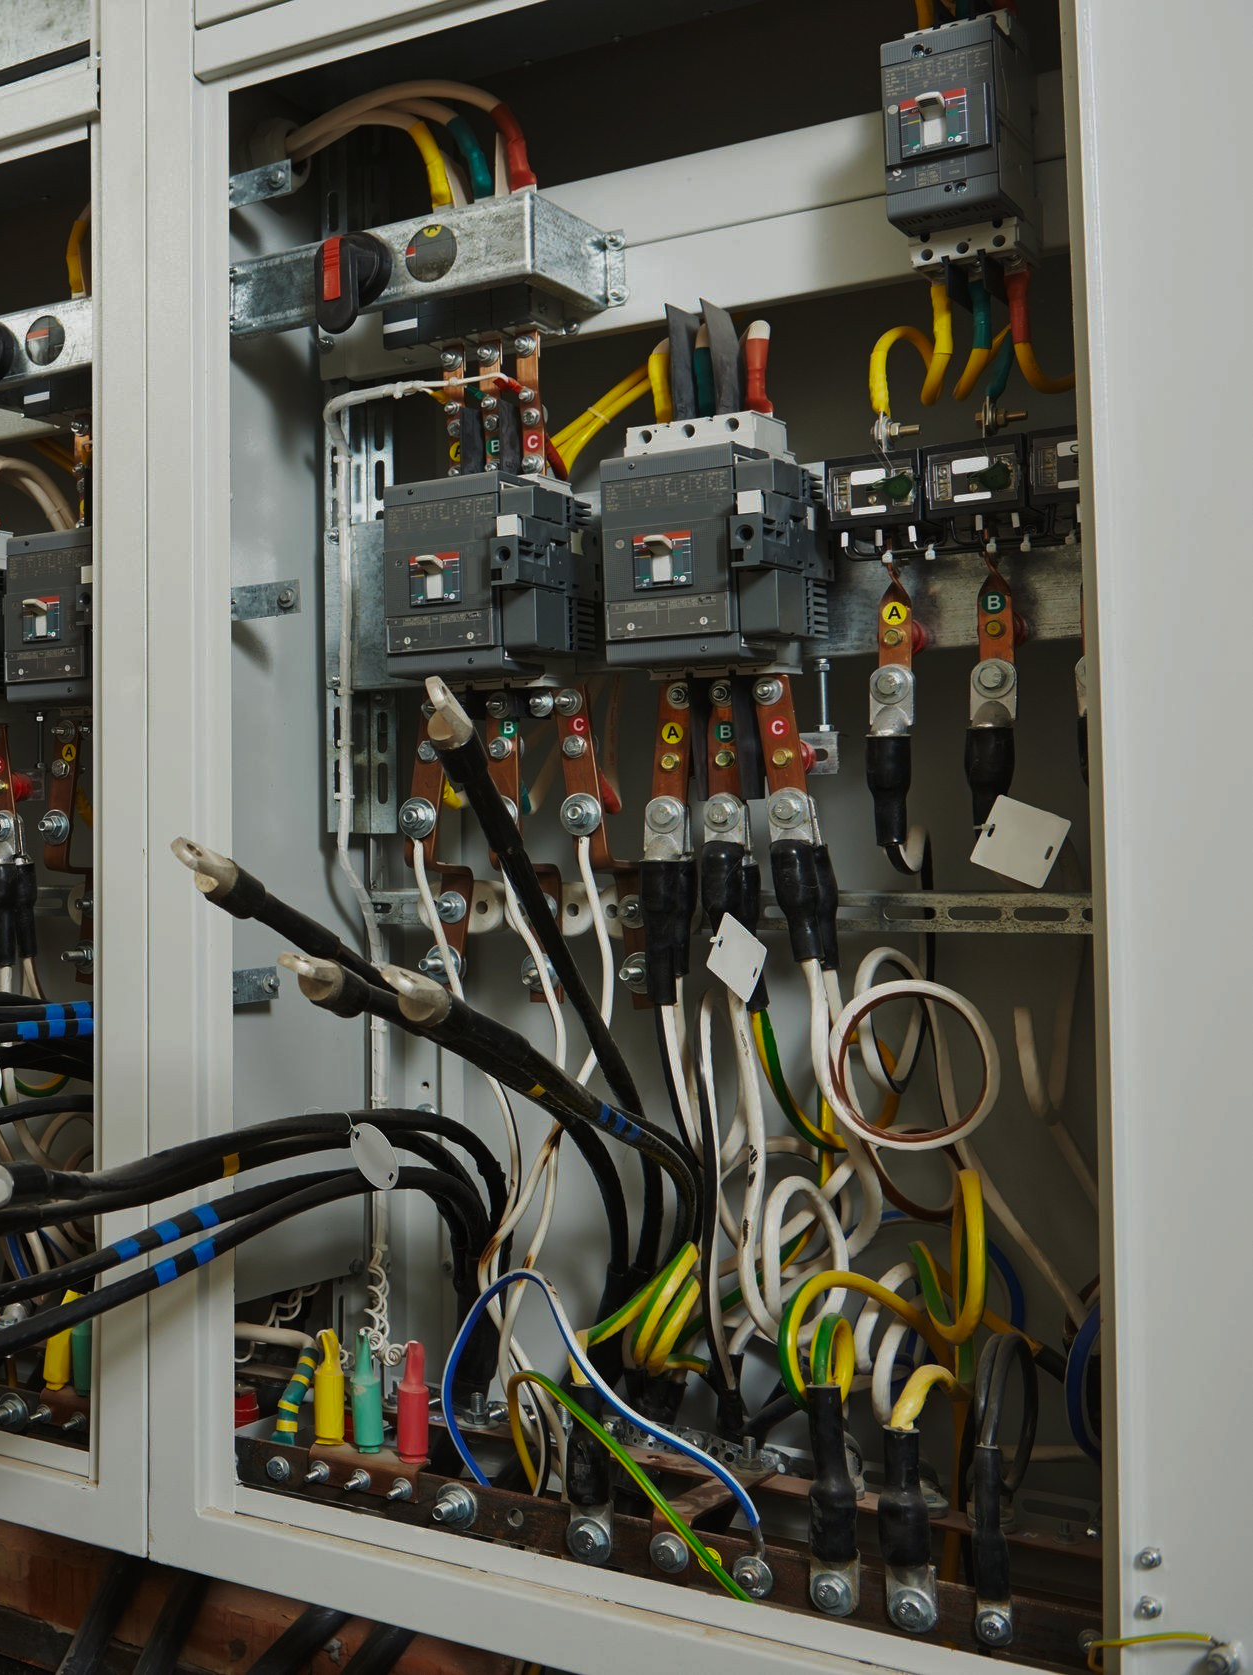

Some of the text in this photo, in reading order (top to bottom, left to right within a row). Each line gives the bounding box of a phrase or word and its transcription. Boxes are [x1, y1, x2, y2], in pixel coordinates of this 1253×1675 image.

[491, 440, 500, 452] B
[527, 435, 539, 448] C
[987, 595, 1001, 610] B
[887, 606, 902, 620] A
[503, 721, 514, 734] B
[573, 718, 585, 731] C
[771, 721, 784, 735] C
[666, 725, 680, 739] A
[720, 725, 732, 739] B
[64, 746, 74, 758] A
